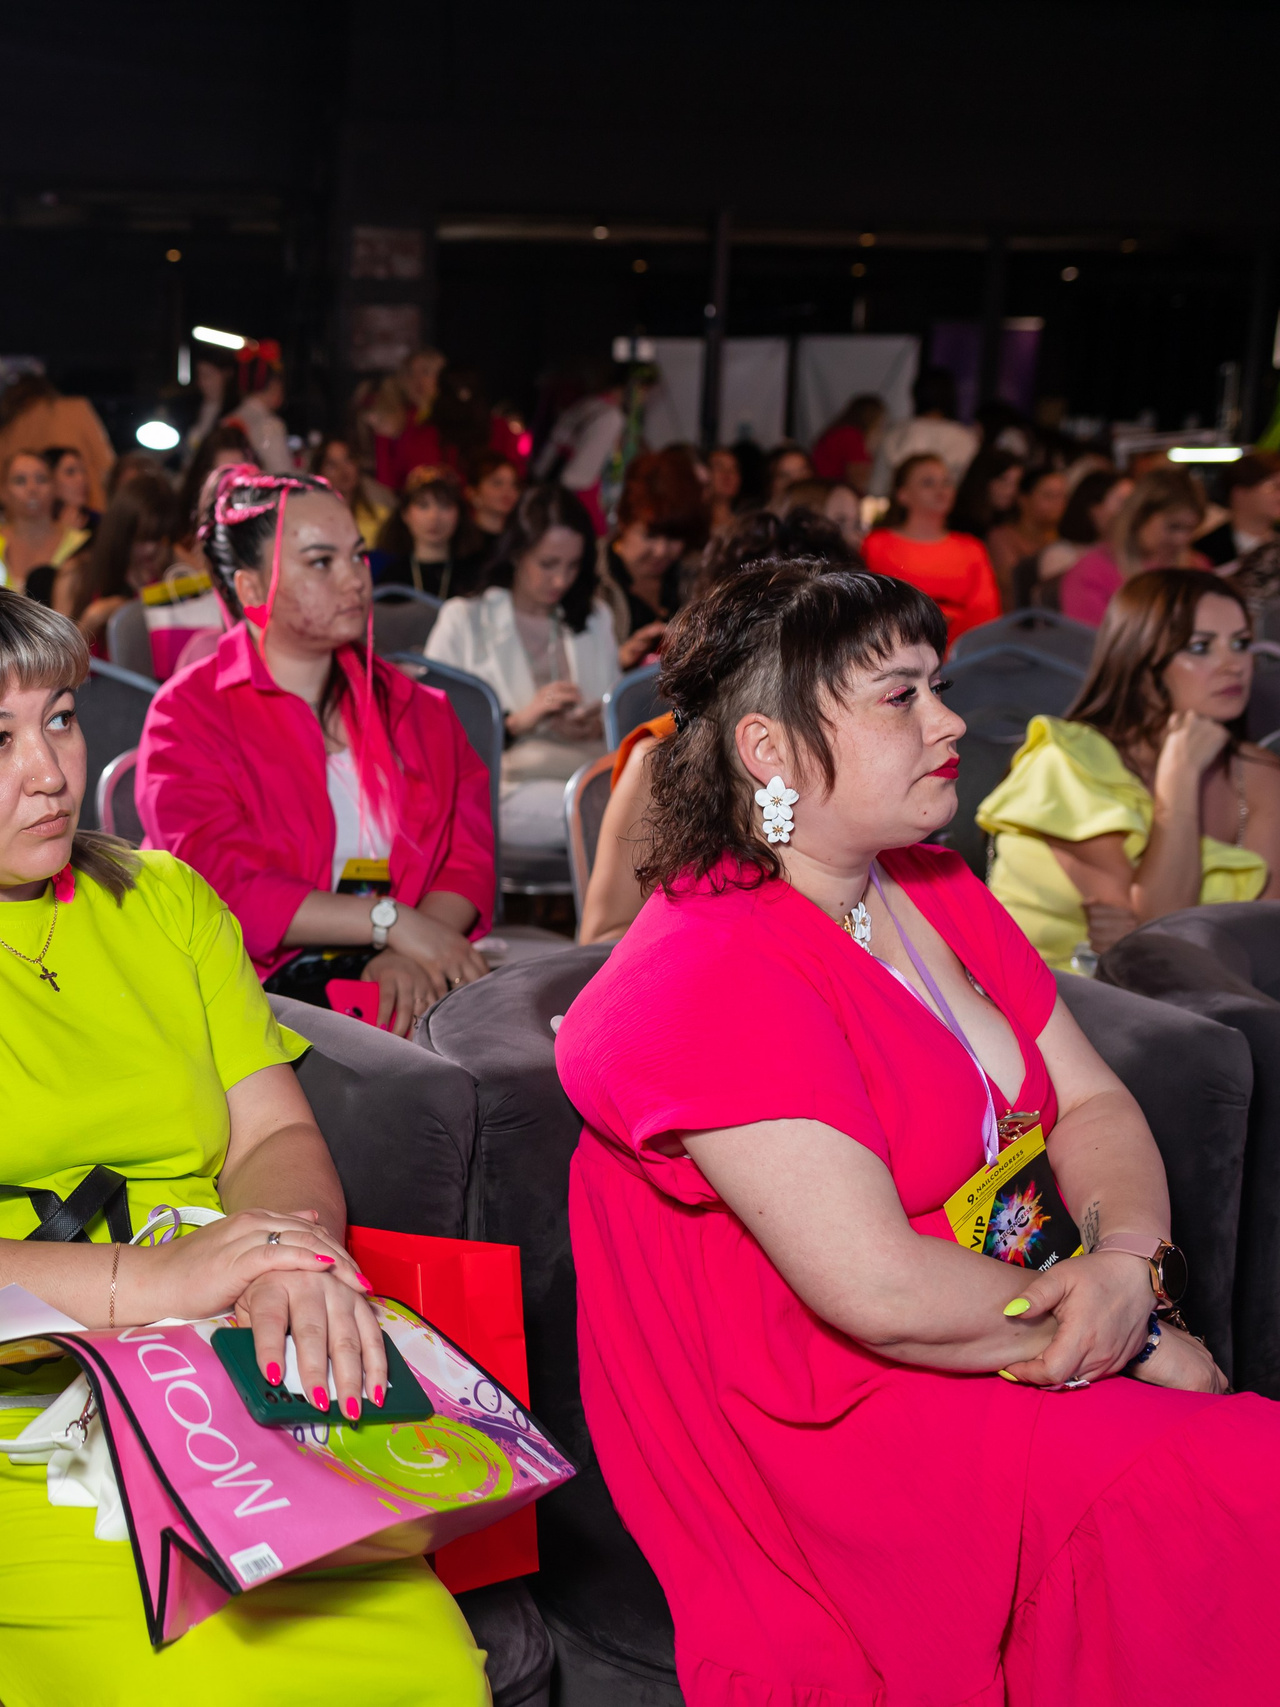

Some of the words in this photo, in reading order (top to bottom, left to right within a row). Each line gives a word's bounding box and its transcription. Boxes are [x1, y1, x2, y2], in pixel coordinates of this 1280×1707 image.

[976, 1150, 1024, 1193] NAILCONGRESS
[970, 1216, 986, 1248] VIP
[995, 1206, 1033, 1246] NAILCONGRESS
